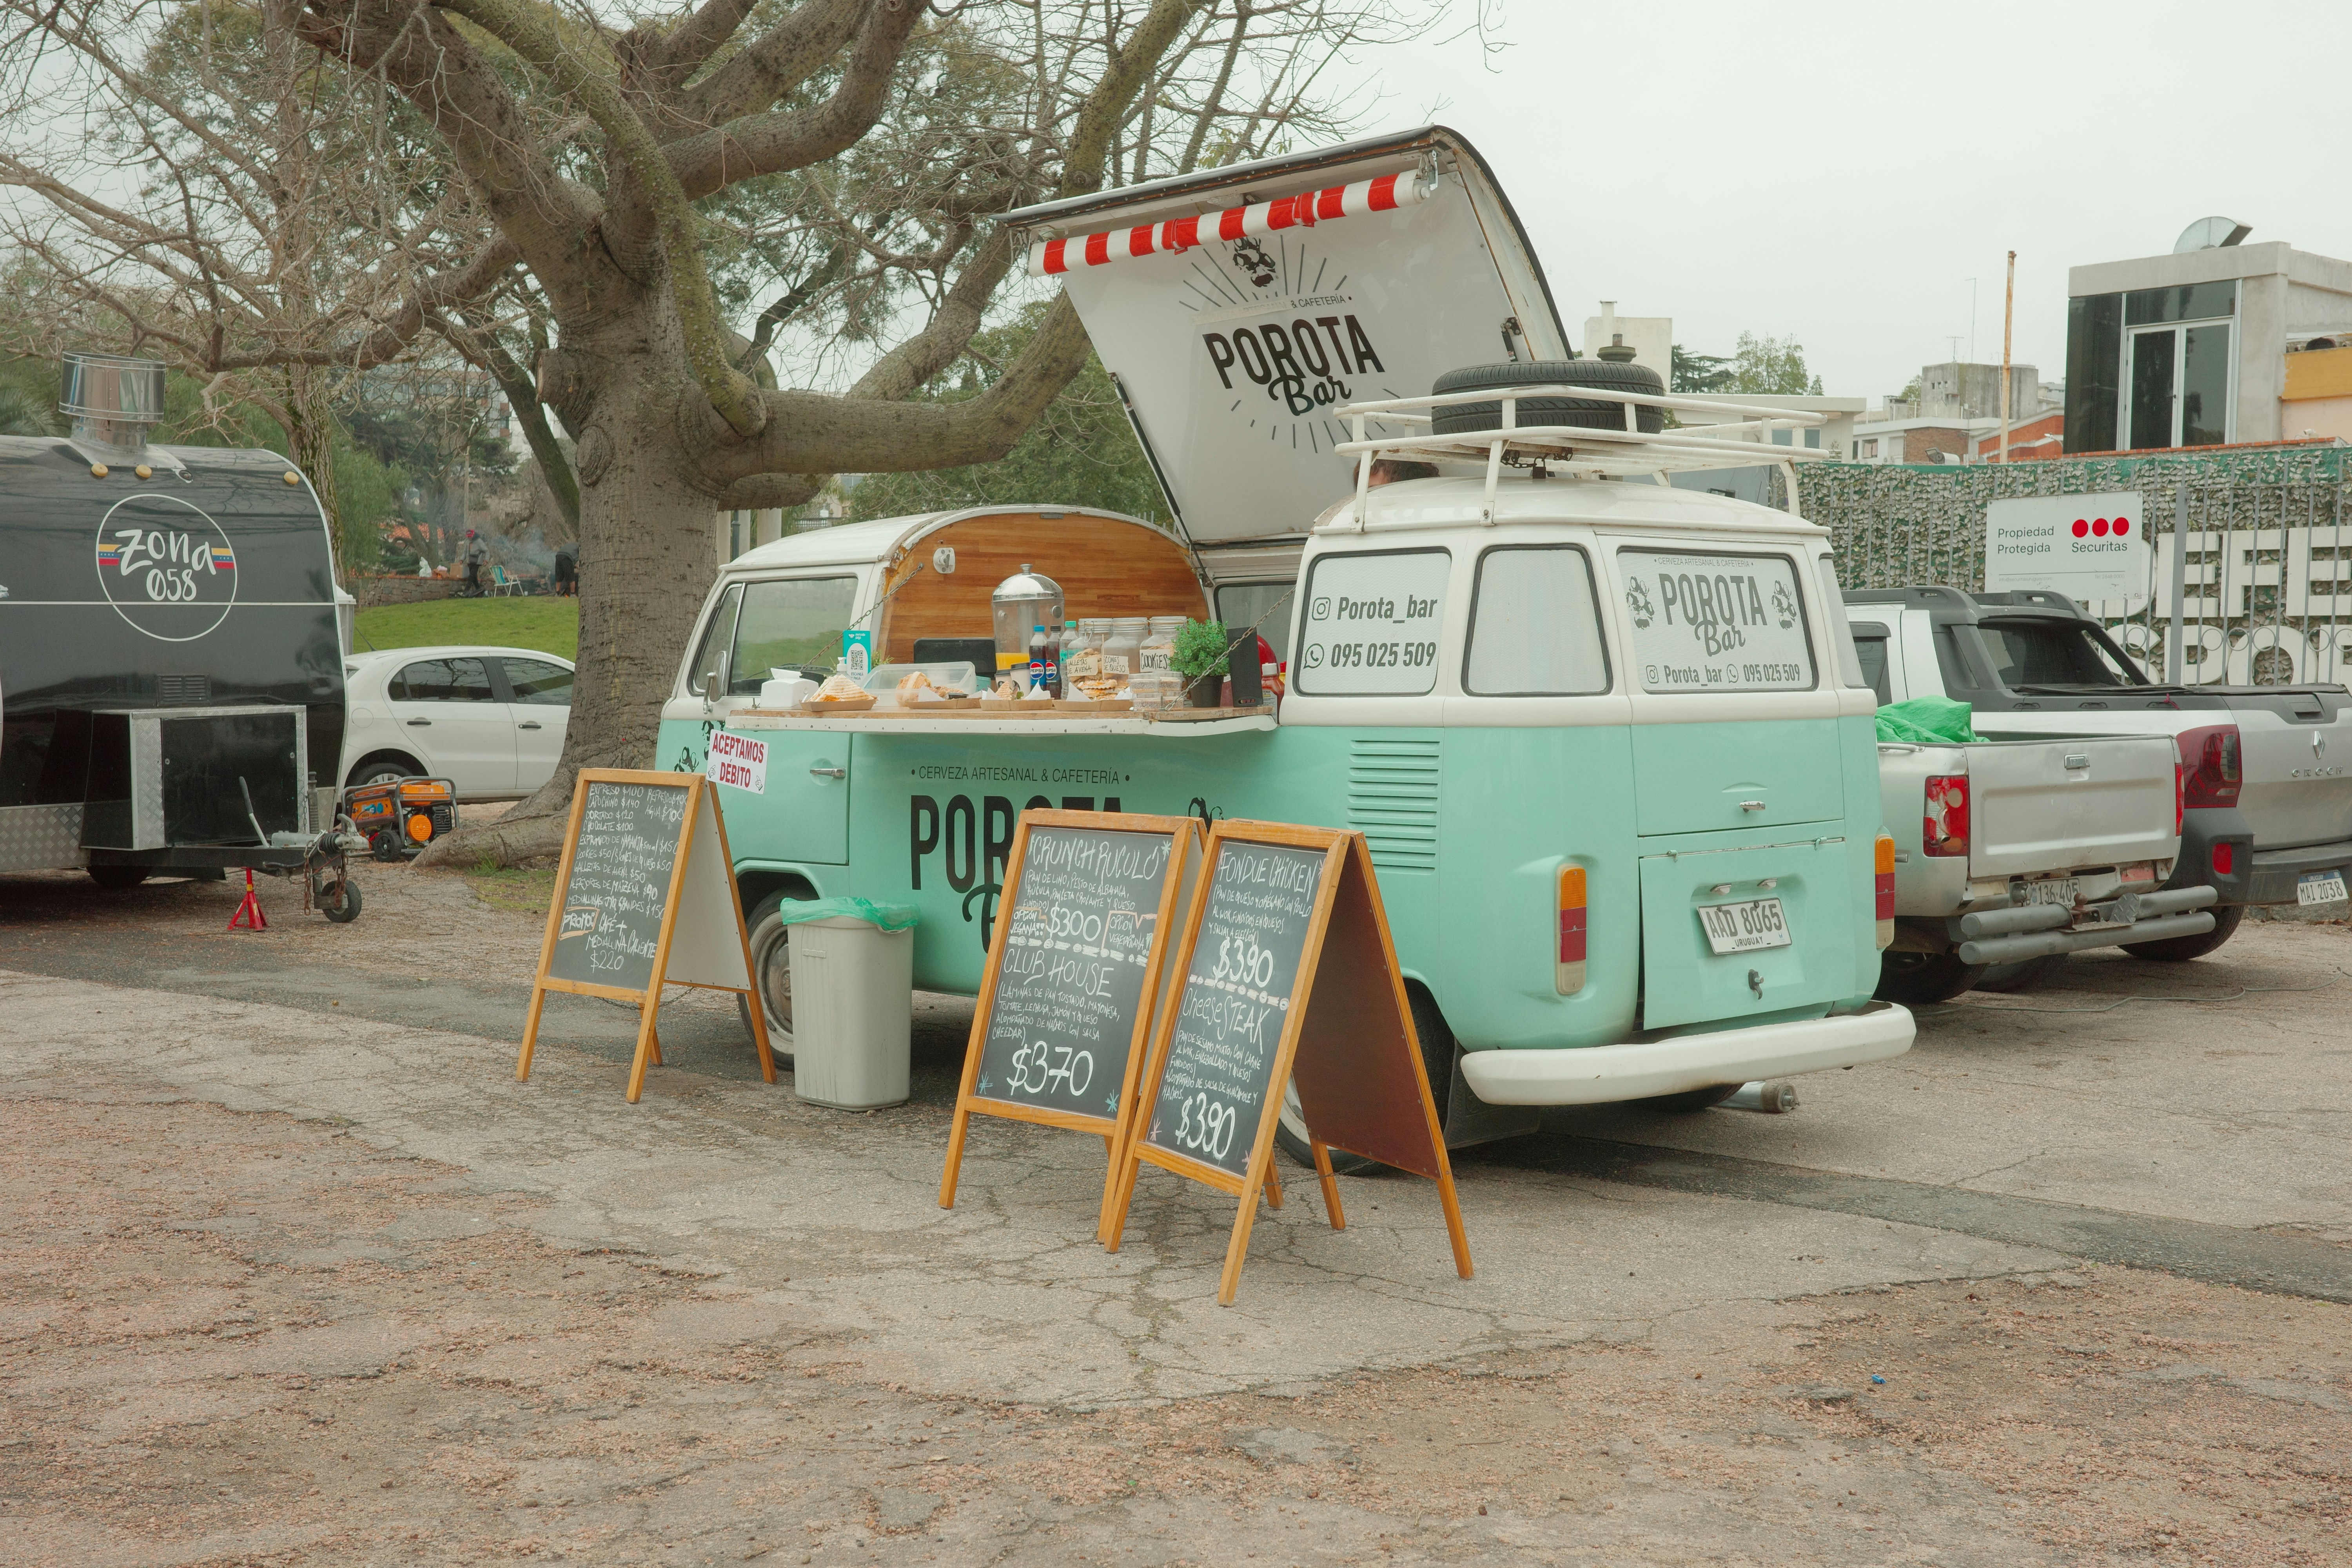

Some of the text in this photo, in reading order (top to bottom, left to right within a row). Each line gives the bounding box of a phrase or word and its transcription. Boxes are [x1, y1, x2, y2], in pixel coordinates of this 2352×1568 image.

[1290, 300, 1297, 309] &
[1298, 293, 1346, 308] CAFETERÍA
[1202, 314, 1385, 389] POROTA
[1268, 374, 1352, 416] Bar
[1998, 526, 2054, 539] Propiedad
[115, 529, 216, 576] Zona
[1998, 543, 2051, 555] Protegida
[2072, 541, 2127, 552] Securitas
[1685, 558, 1715, 566] ARTESANAL
[1721, 558, 1749, 567] CAFETERÍA
[146, 569, 197, 601] 058
[1337, 594, 1437, 623] Porota_bar
[1659, 573, 1767, 626] POROTA
[1694, 619, 1746, 657] Bar
[1141, 653, 1168, 670] COOKIES
[1331, 642, 1436, 667] 095 025 509
[1110, 664, 1125, 673] QUESO
[1664, 664, 1800, 686] Porota_bar 095 025 509
[712, 733, 764, 763] ACEPTAMOS
[719, 759, 751, 788] DÉBITO
[918, 766, 1120, 784] CERVEZA ARTESANAL & CAFETERÍA
[2292, 766, 2343, 777] OROCH
[589, 784, 644, 797] EXPRESO $100
[621, 797, 640, 808] $140
[645, 804, 684, 822] AGUA $100
[583, 820, 633, 832] CHOCOLATE $100
[586, 810, 633, 821] CORTADO $120
[577, 848, 597, 859] COOKIES
[657, 859, 671, 871] $50
[1033, 836, 1095, 871] CRUNCH
[574, 861, 645, 883] GALLETAS DE AVENA $50
[1042, 873, 1052, 883] DE
[1089, 883, 1096, 893] DE
[1220, 852, 1318, 902] FONDUE CHICKEN
[603, 880, 611, 889] DE
[643, 884, 657, 901] $90
[1076, 892, 1104, 907] CROCANTE
[1107, 897, 1112, 909] Y
[1113, 898, 1136, 911] QUESO
[2299, 880, 2343, 903] MAI 2038
[618, 896, 644, 914] GRANDES
[1227, 890, 1235, 901] DE
[1235, 891, 1254, 906] QUESO
[1255, 896, 1259, 907] Y
[1285, 897, 1293, 917] CON
[1293, 898, 1312, 917] POLLO
[599, 912, 627, 936] CAFÉ +
[1046, 902, 1101, 941] $300
[1209, 922, 1234, 939] Y SALSAS A
[1212, 906, 1219, 918] AL
[1255, 917, 1262, 929] EN
[1263, 913, 1285, 934] QUESOS
[1706, 904, 1782, 938] AAD 8065
[586, 932, 627, 953] MEDIALUNA
[1735, 936, 1764, 947] URUGUAY
[590, 950, 624, 973] $220
[1004, 948, 1114, 998] CLUB HOUSE
[1212, 937, 1273, 988] $390
[1034, 988, 1043, 998] DE
[1044, 989, 1055, 1001] PAN
[1036, 1017, 1045, 1028] DE
[1046, 1019, 1066, 1032] NACHOS
[1069, 1024, 1079, 1039] CON
[1082, 1027, 1100, 1041] SALSA
[1072, 1012, 1076, 1022] Y
[1077, 1013, 1098, 1024] QUESO
[1188, 1032, 1195, 1043] DE
[1233, 1044, 1244, 1062] CON
[1244, 1051, 1262, 1070] CARNE
[1007, 1041, 1093, 1096] $370
[1176, 1045, 1183, 1054] AL
[1229, 1063, 1232, 1076] Y
[1233, 1065, 1252, 1083] QUESOS
[1195, 1078, 1203, 1089] DE
[1203, 1079, 1218, 1091] SALSA
[1218, 1082, 1226, 1093] DE
[1252, 1091, 1258, 1106] Y
[1175, 1092, 1235, 1160] $390
